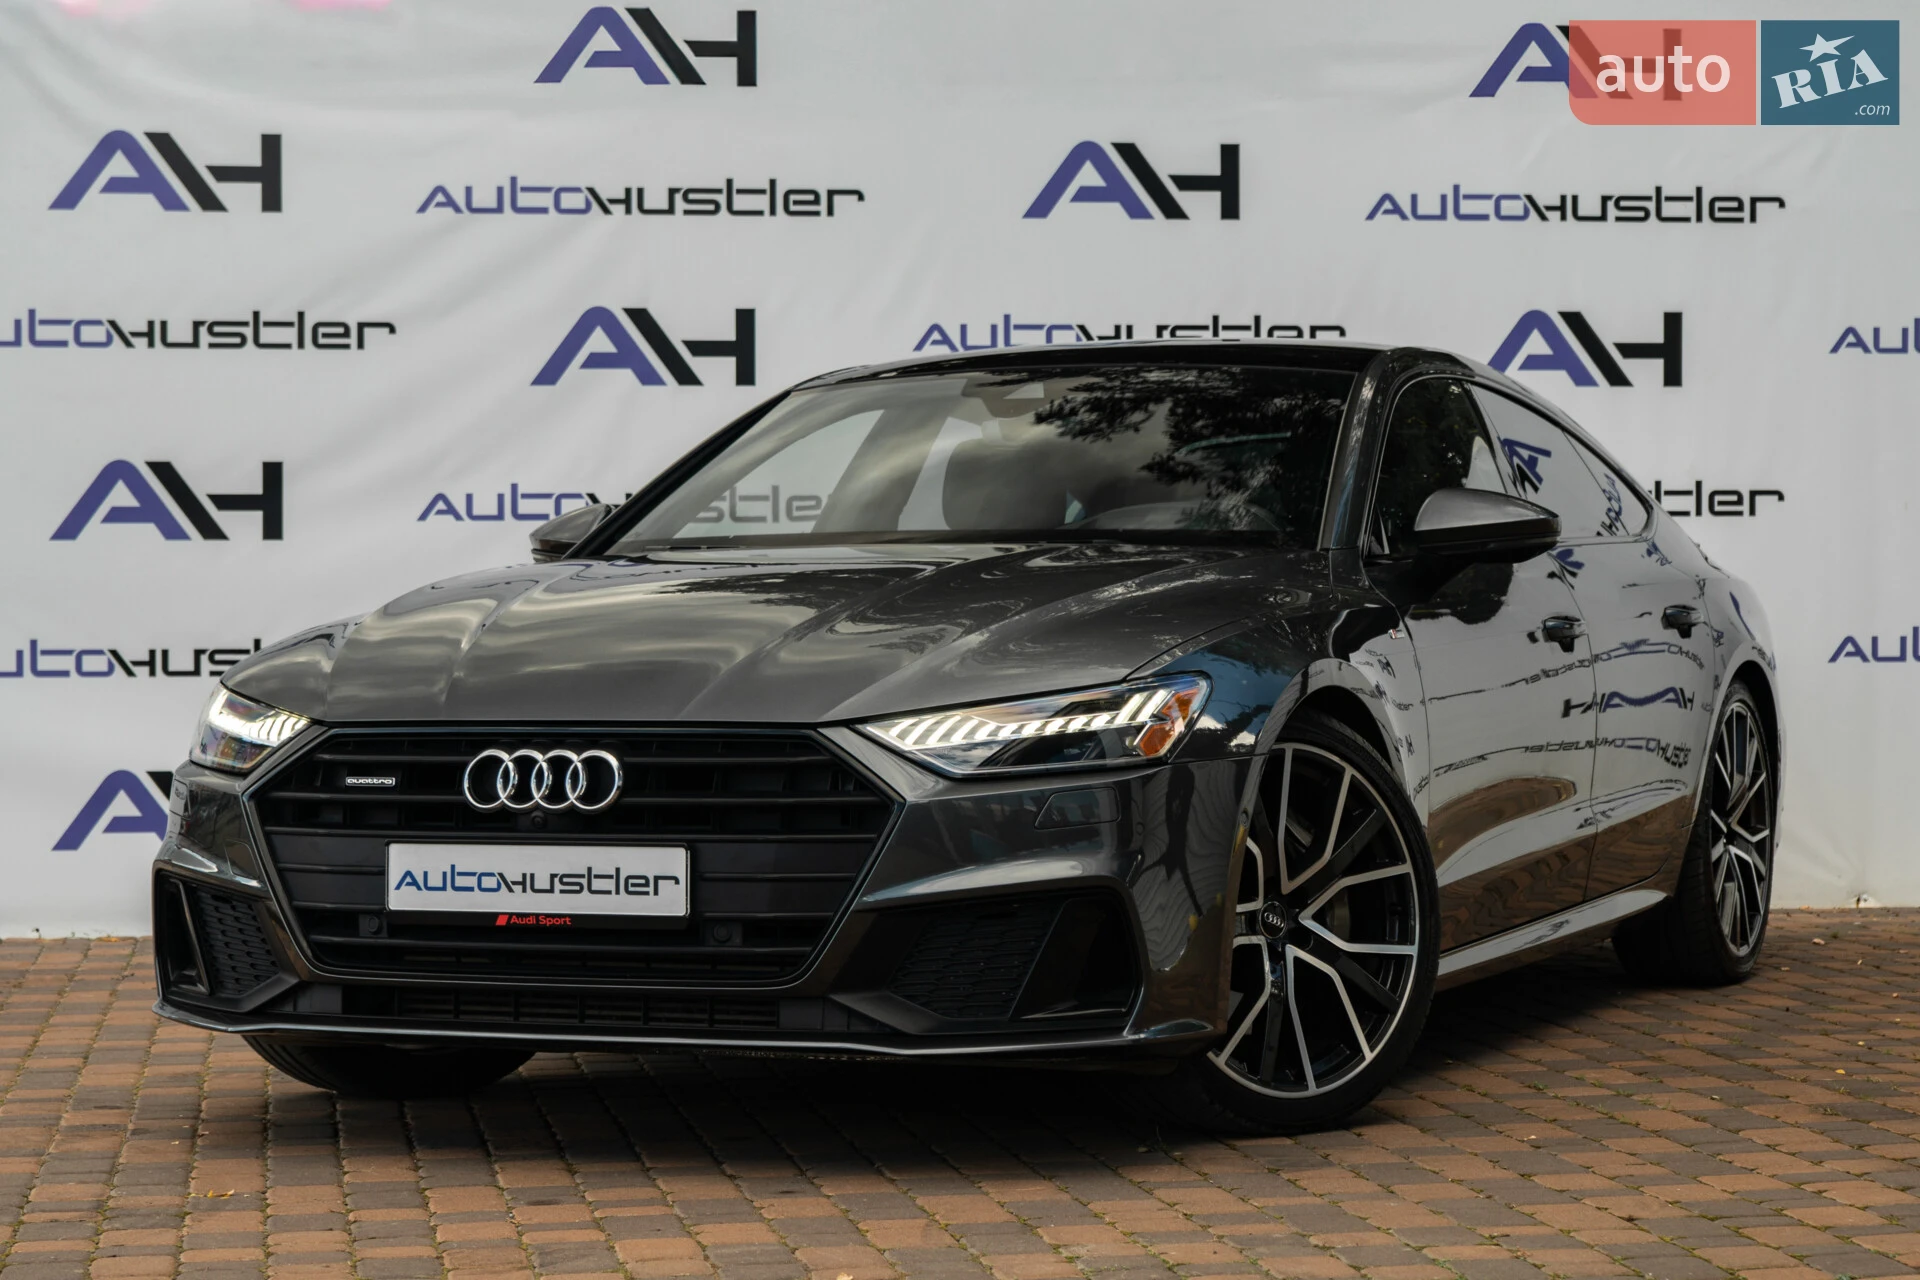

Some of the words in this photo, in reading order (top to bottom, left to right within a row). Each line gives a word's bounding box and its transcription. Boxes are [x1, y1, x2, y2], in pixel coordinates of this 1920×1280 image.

[534, 7, 757, 87] AH
[49, 130, 282, 212] AH
[1023, 141, 1240, 220] AH
[0, 309, 396, 350] utoHustler
[531, 307, 755, 386] AH
[1488, 310, 1682, 387] AH
[50, 460, 283, 540] AH
[347, 777, 393, 785] quattro
[510, 915, 536, 925] Audi
[539, 915, 571, 926] Sport
